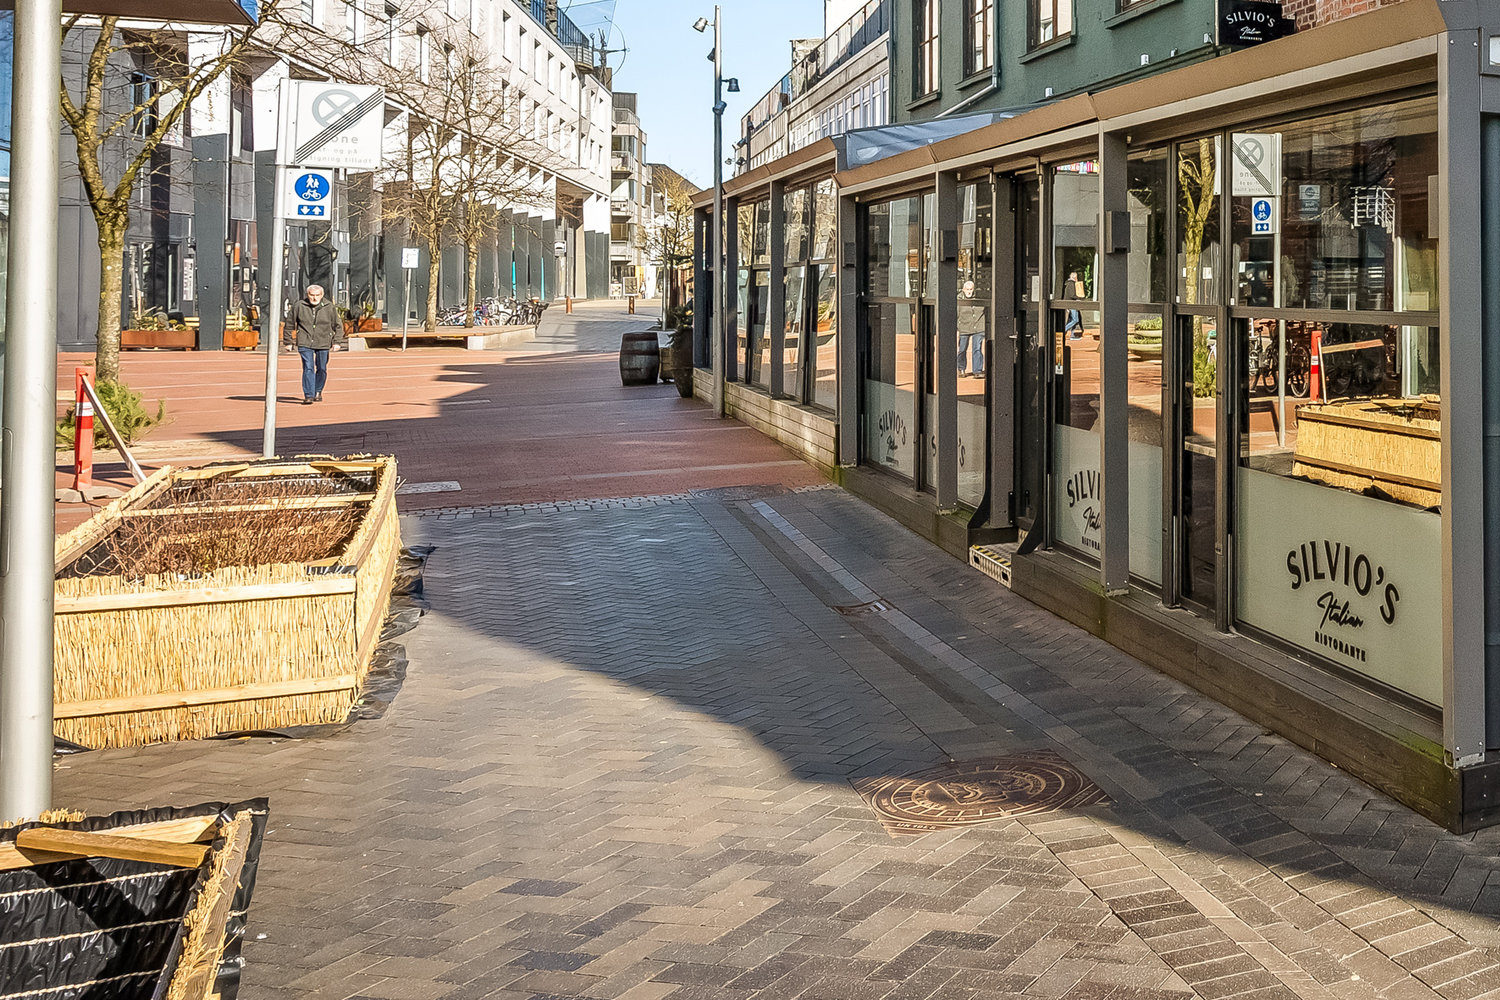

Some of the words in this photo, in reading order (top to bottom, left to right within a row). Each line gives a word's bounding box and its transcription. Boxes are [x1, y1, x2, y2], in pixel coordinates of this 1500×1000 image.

[1225, 10, 1276, 28] SILVIO'S
[329, 134, 359, 144] one
[879, 410, 907, 446] SILVIO'S
[1066, 469, 1100, 508] SILVI
[1286, 539, 1400, 625] SILVIO'S
[1316, 591, 1364, 630] Italian
[1314, 630, 1366, 663] RISTORANTE
